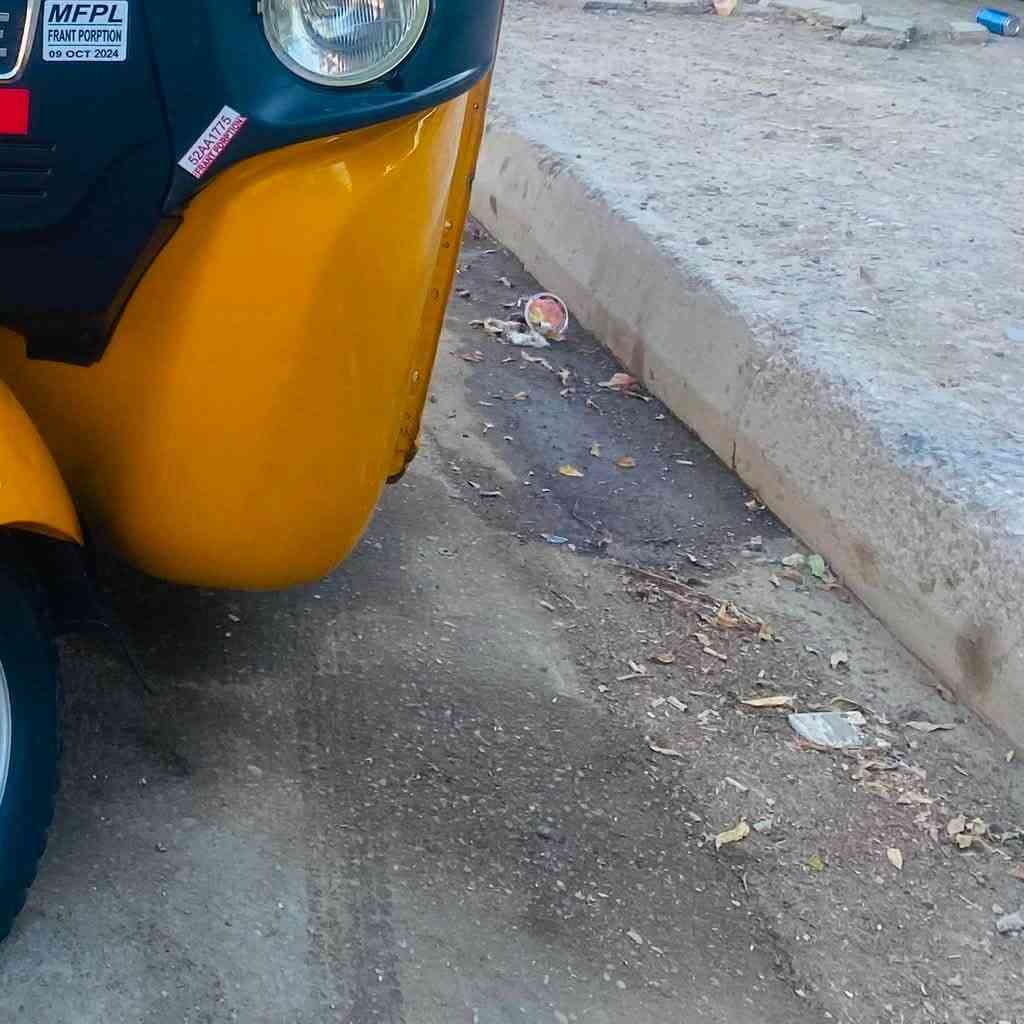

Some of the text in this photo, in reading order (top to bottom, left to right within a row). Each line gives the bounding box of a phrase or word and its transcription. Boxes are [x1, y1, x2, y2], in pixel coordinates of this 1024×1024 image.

[48, 4, 123, 23] MFPL
[48, 29, 122, 43] FRANT PORPTION
[49, 49, 119, 58] 09 OCT 2024
